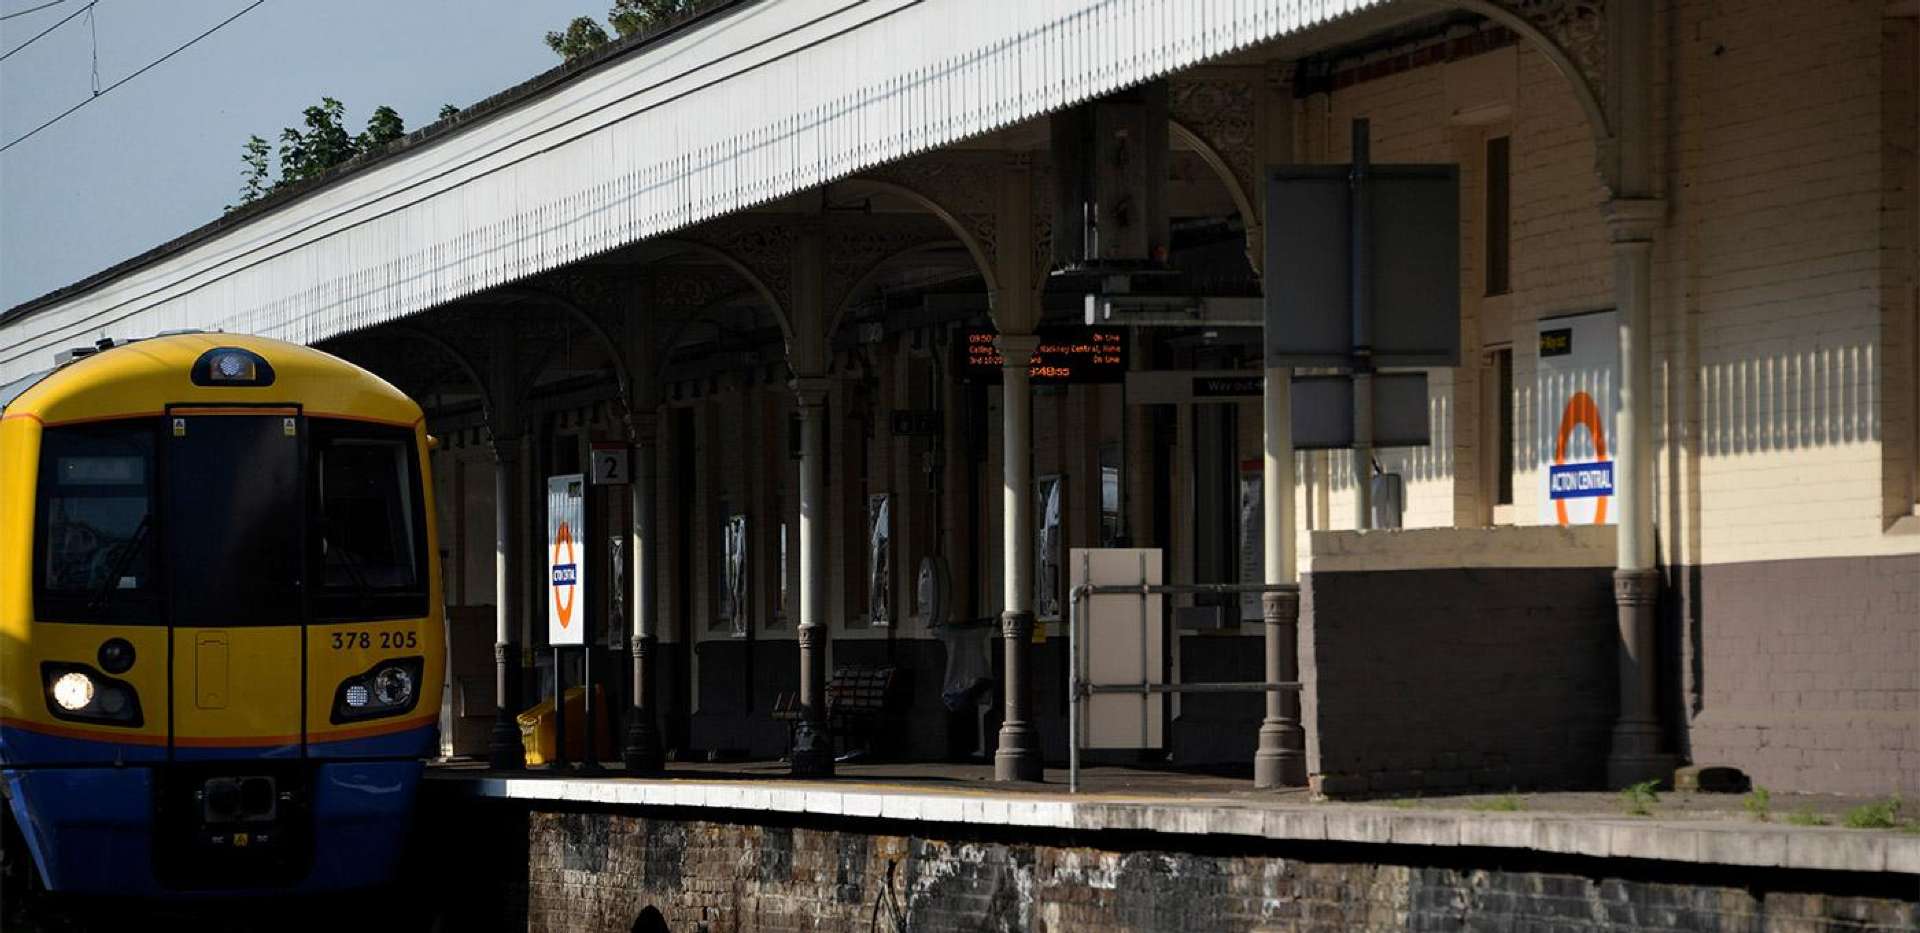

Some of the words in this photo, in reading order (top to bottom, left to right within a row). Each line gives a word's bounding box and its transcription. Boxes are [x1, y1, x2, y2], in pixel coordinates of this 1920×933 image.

[604, 456, 618, 478] 2
[1552, 472, 1577, 491] ACTON
[1578, 470, 1612, 490] CENTRAL
[331, 632, 371, 649] 378
[379, 631, 417, 648] 205
